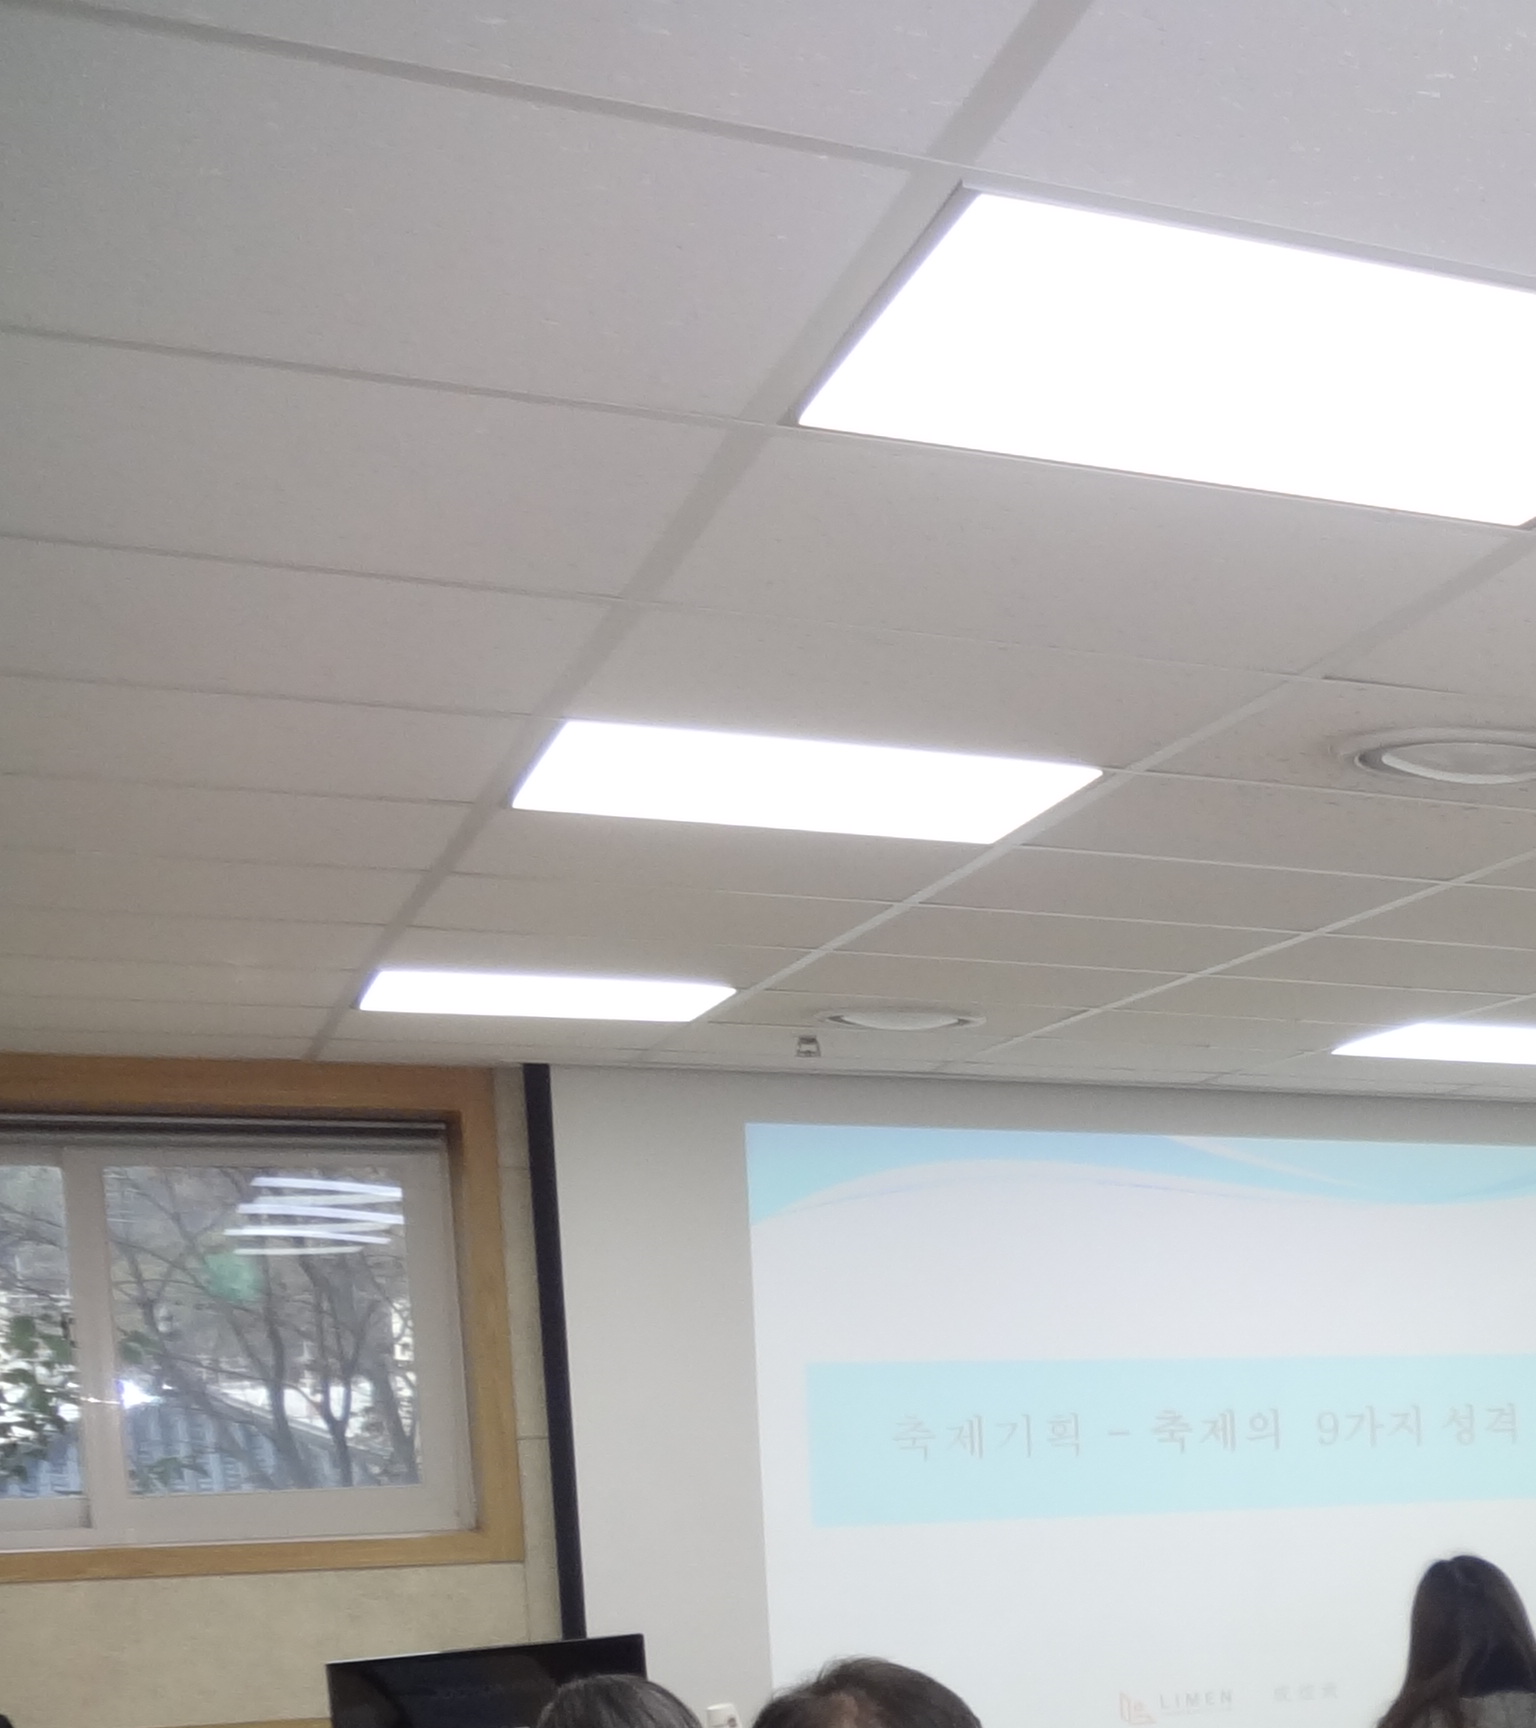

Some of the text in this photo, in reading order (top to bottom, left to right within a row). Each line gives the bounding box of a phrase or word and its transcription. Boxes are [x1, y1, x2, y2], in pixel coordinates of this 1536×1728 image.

[892, 1411, 1084, 1462] 축제기획
[1149, 1404, 1283, 1455] 축제의
[1315, 1403, 1426, 1449] 9가지
[1441, 1401, 1522, 1448] 성격
